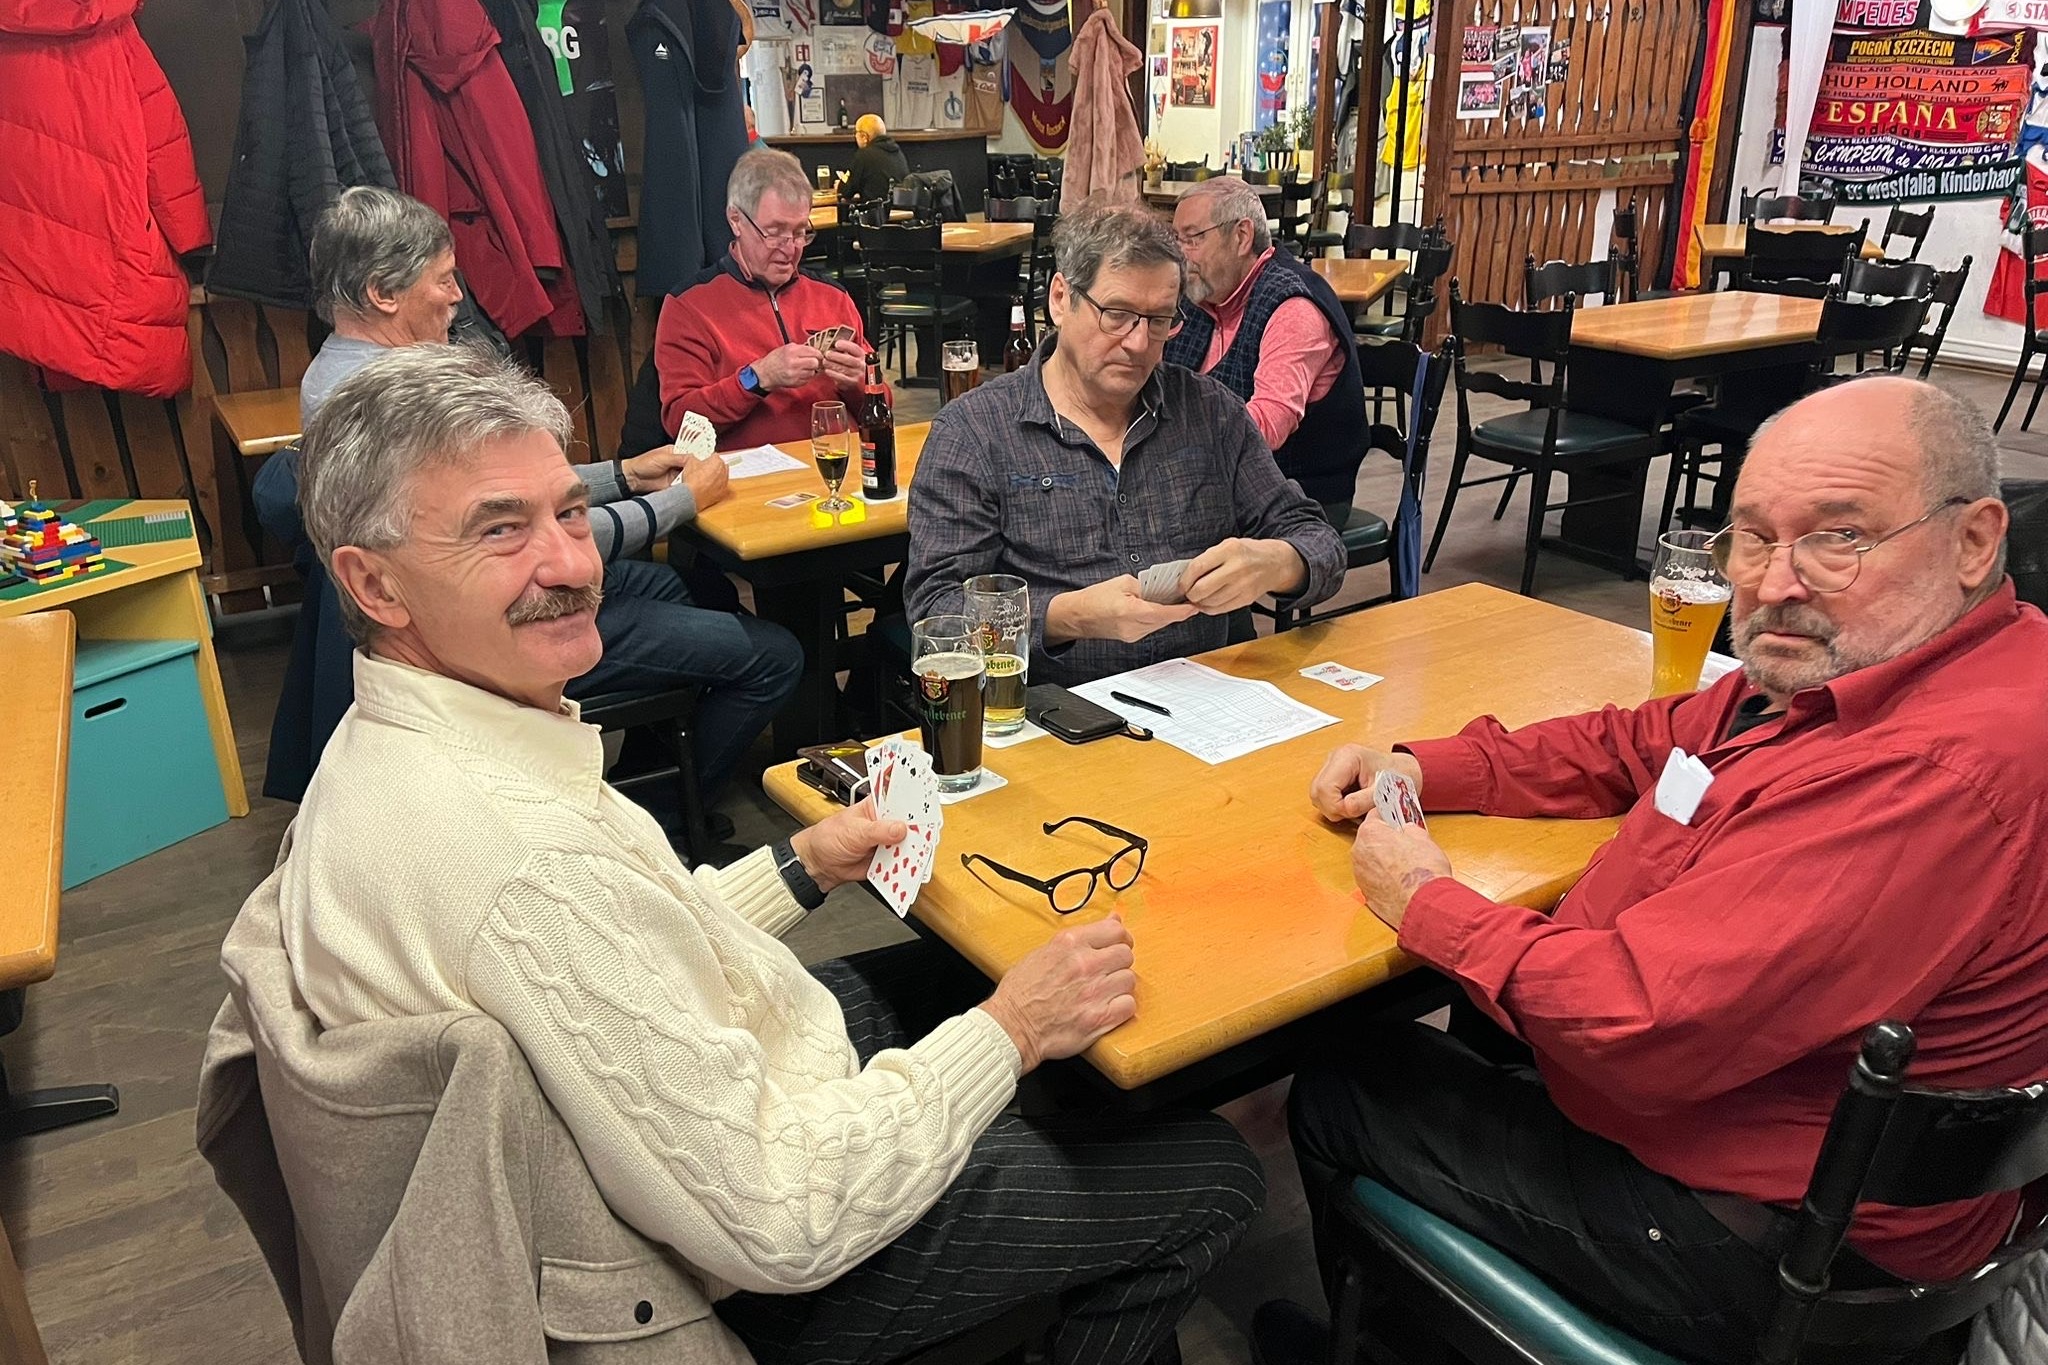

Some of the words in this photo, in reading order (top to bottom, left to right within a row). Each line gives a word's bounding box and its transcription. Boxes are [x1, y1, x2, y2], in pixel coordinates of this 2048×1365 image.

[1838, 0, 1920, 25] MPEDES
[541, 26, 581, 59] RG
[1893, 39, 1956, 57] SZCZECIN
[1825, 74, 1868, 89] HUP
[1875, 75, 1979, 93] HOLLAND
[1828, 100, 1957, 130] ESPAÑA
[1857, 123, 1921, 139] adidas
[1814, 144, 1895, 164] CAMPEON
[1895, 152, 1911, 168] de
[1949, 146, 1982, 155] MADRID
[1867, 172, 1936, 200] Westfalia
[1940, 166, 2020, 194] Kinderhau
